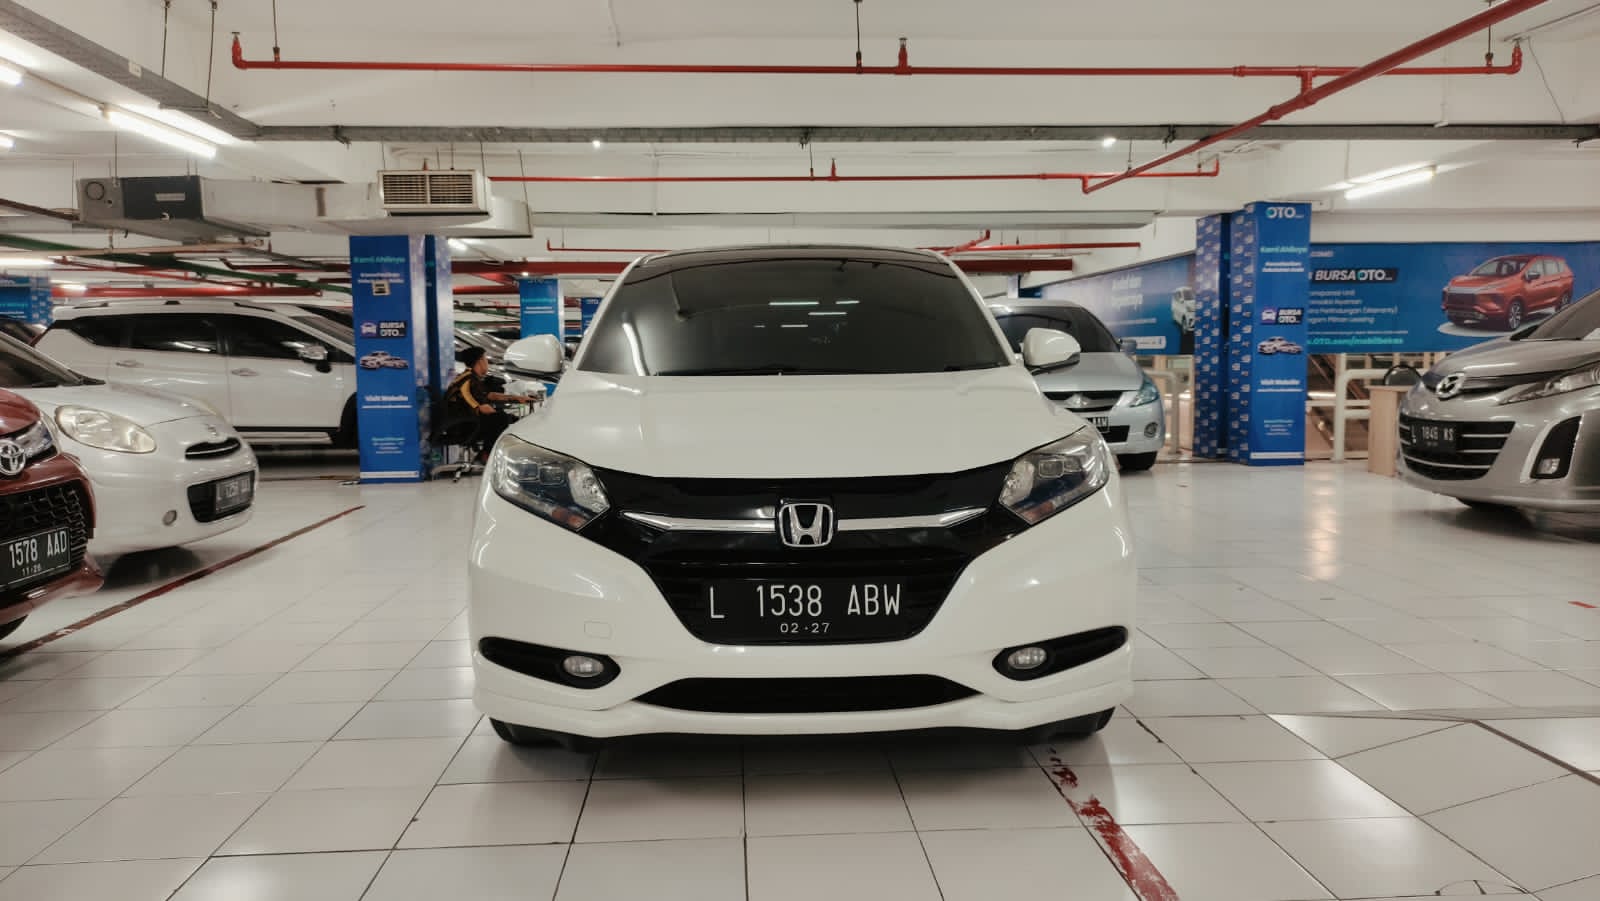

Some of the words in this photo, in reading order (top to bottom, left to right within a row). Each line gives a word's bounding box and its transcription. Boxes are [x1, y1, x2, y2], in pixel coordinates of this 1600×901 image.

[1315, 270, 1356, 281] BURSA
[9, 538, 38, 569] 1578
[47, 530, 67, 558] AAD
[709, 586, 725, 619] L
[756, 584, 823, 617] 1538
[847, 583, 901, 616] ABW
